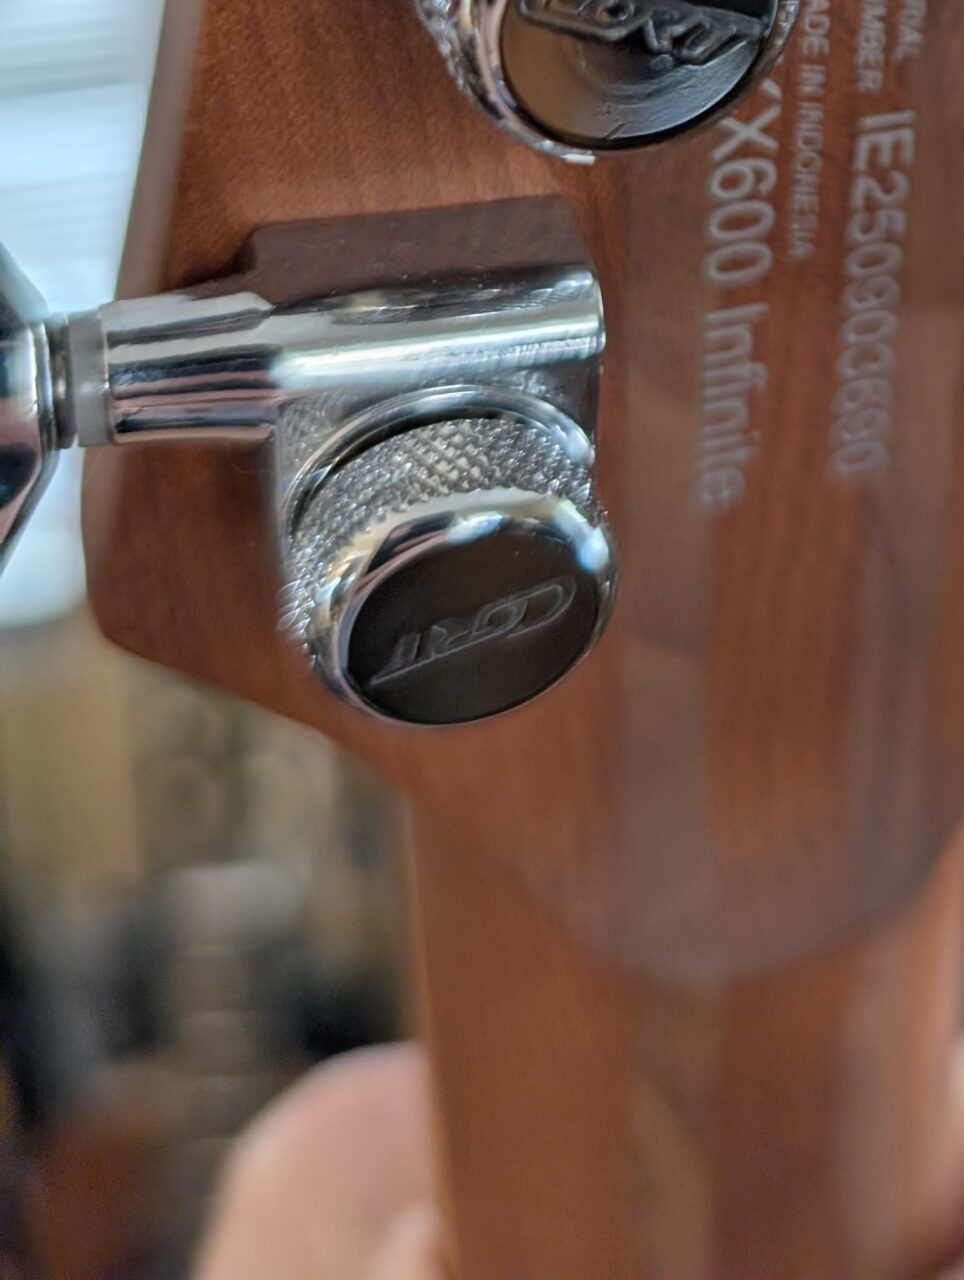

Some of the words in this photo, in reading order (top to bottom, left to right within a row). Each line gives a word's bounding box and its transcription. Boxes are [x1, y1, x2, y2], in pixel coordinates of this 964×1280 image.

[799, 64, 827, 97] IN
[787, 101, 825, 260] INDONESIA
[694, 302, 770, 510] Infinite
